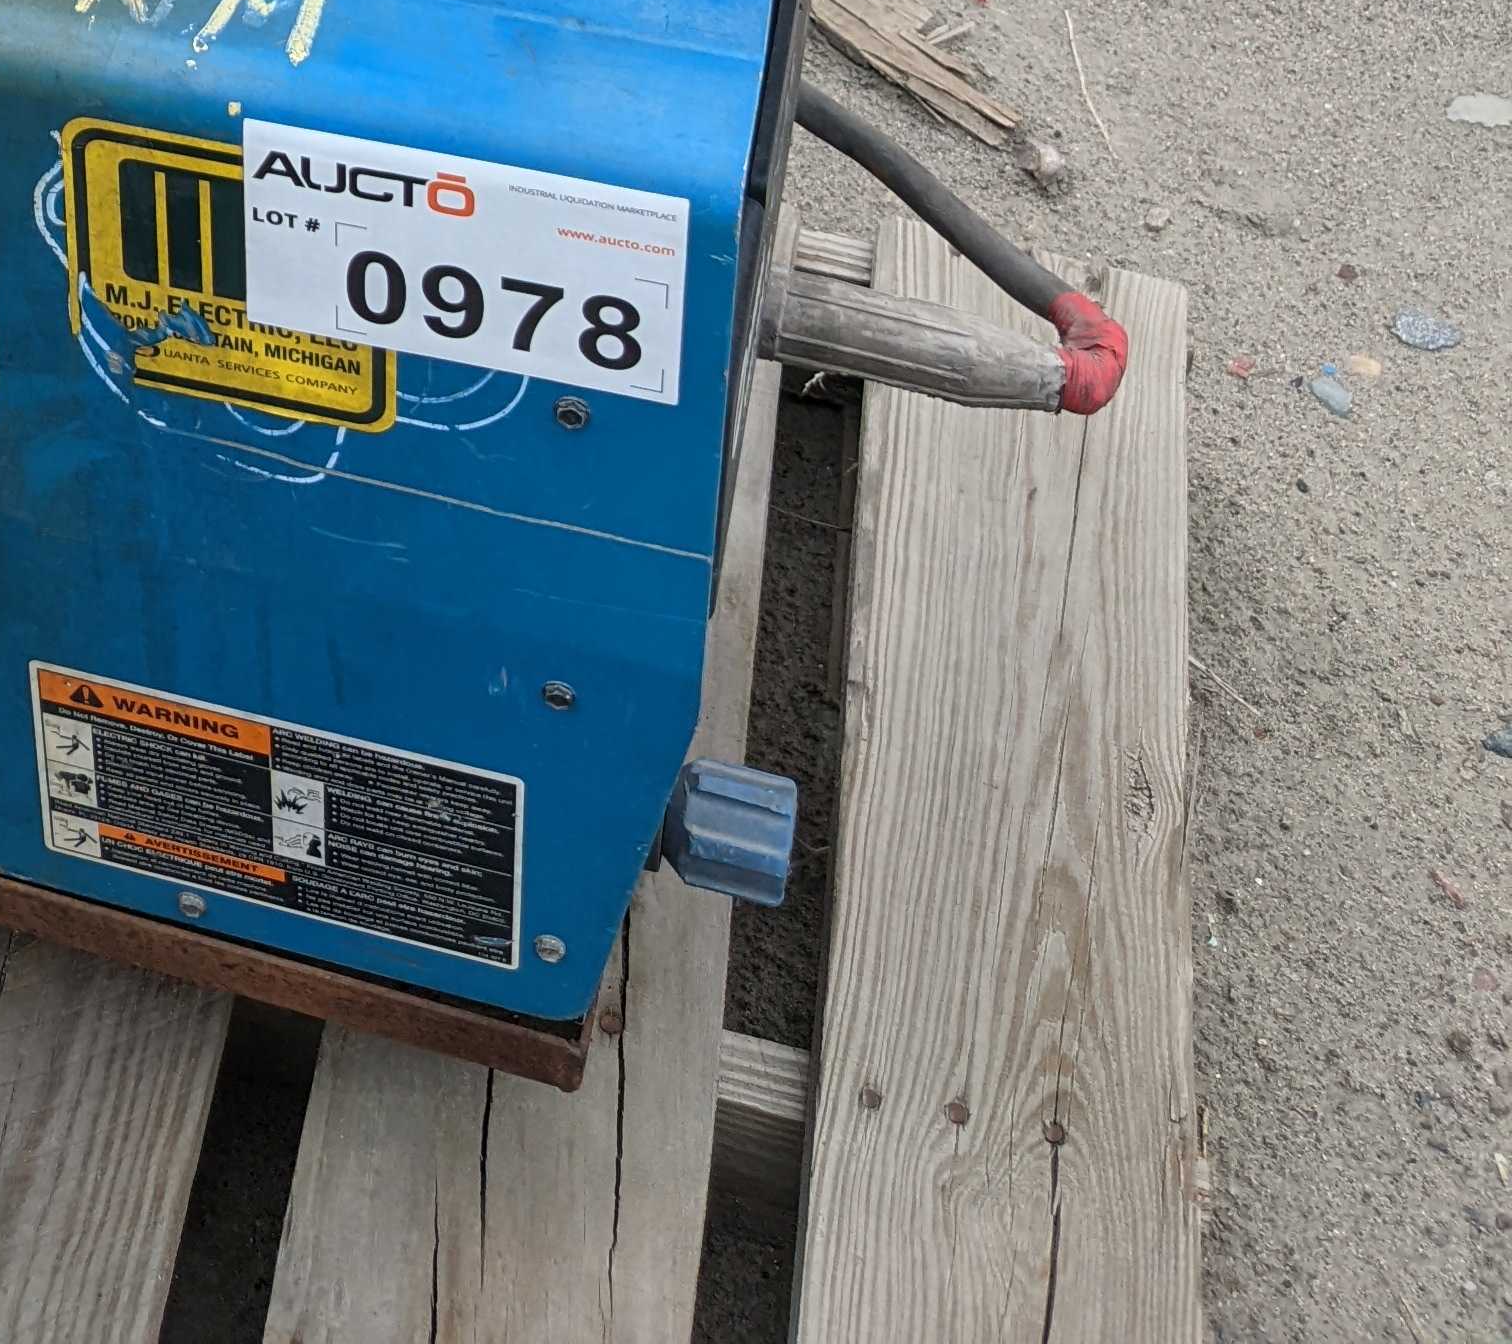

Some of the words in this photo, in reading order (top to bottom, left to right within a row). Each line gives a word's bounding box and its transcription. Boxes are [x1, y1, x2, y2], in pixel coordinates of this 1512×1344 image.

[252, 206, 299, 230] LOT
[304, 216, 321, 233] #
[508, 183, 558, 201] INDUSTRIAL
[559, 193, 615, 213] LIQUIDATION
[616, 204, 678, 223] MARKETPLACE
[556, 226, 677, 258] www.aucto.com
[105, 282, 160, 313] M.J.
[345, 249, 642, 373] 0978
[216, 358, 281, 381] SERVICES
[285, 372, 358, 397] COMPANY
[263, 342, 362, 376] MICHIGAN
[112, 695, 240, 740] WARNING
[144, 836, 258, 873] AVERTISSEMENT
